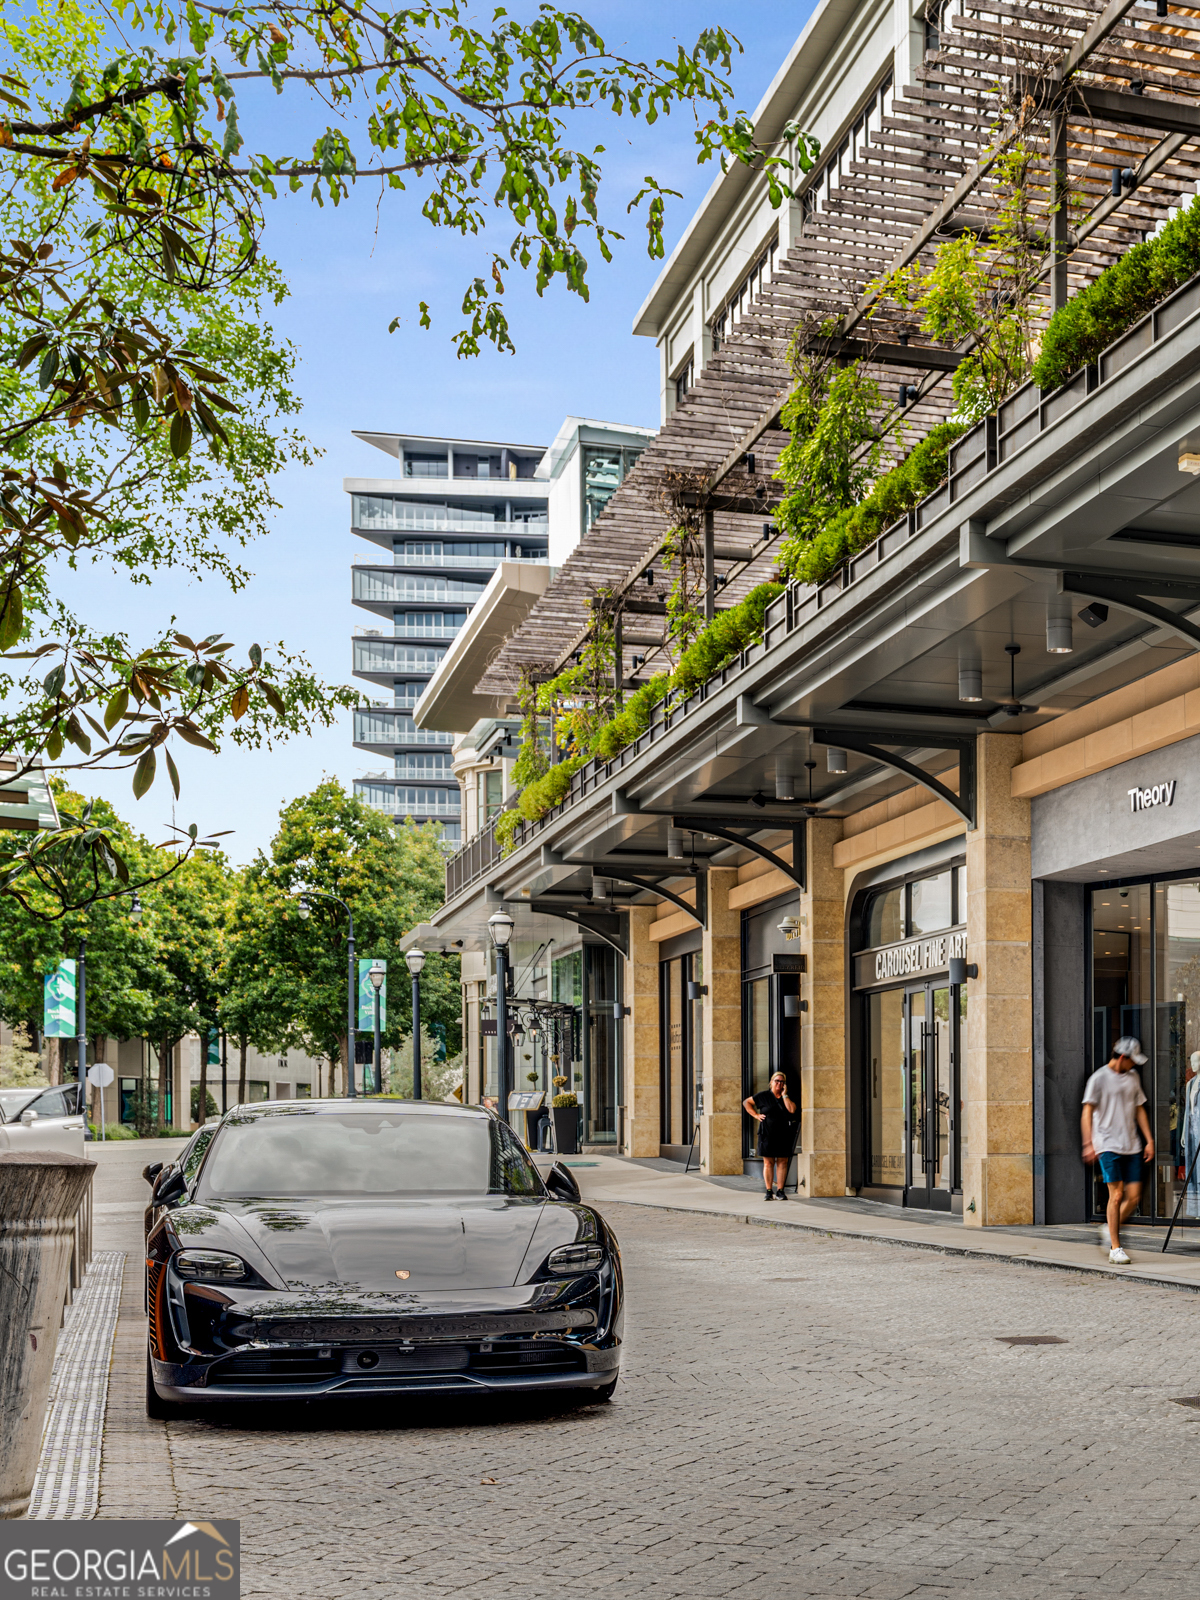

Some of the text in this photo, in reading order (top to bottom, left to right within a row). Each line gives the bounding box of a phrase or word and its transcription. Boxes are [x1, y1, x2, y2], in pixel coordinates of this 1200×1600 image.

[1127, 780, 1176, 812] Theory
[875, 932, 967, 980] CAROUSEL FINE ART
